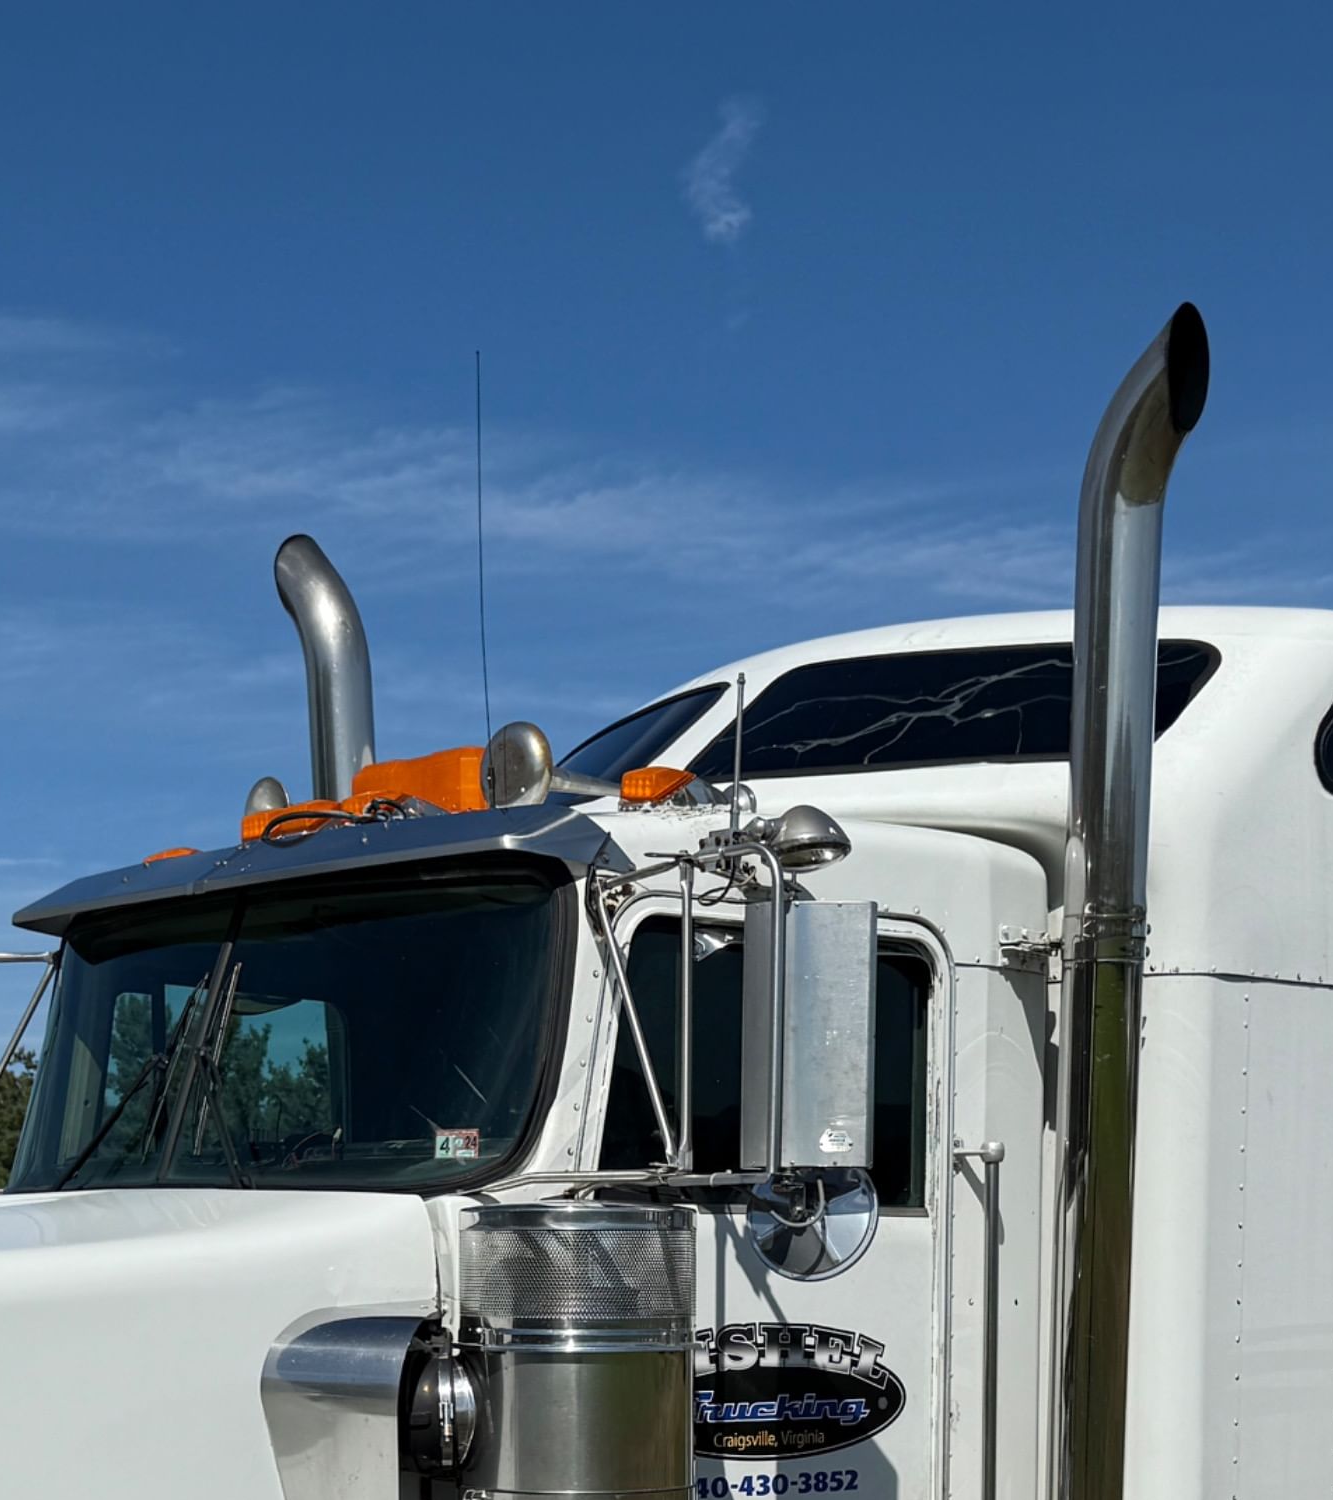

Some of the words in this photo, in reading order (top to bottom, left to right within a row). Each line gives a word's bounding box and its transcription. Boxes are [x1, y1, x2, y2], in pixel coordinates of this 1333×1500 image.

[440, 1136, 451, 1153] 4
[464, 1135, 477, 1149] 24
[694, 1390, 871, 1425] Trucking
[713, 1430, 778, 1451] Craigsville,
[780, 1430, 825, 1448] Virginia
